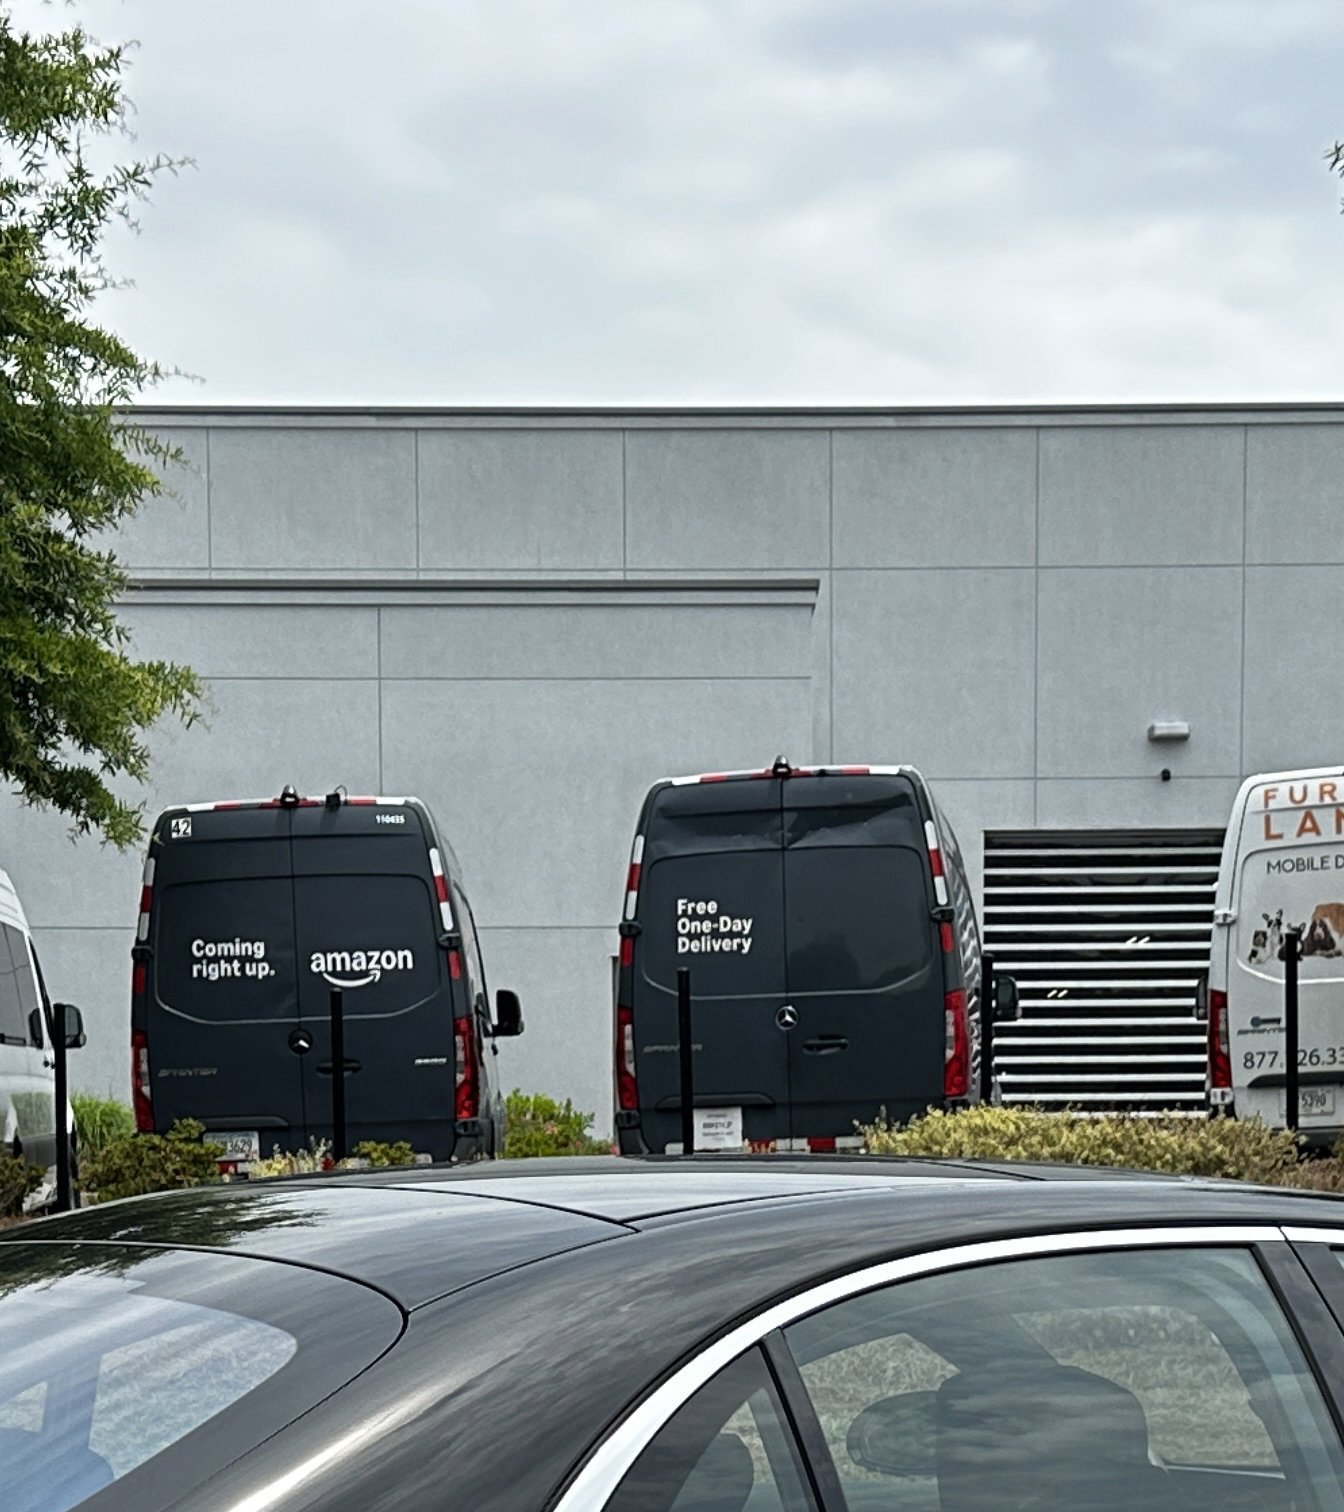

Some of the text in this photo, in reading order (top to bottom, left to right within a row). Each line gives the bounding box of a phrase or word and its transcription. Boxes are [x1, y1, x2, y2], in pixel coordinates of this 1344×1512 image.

[171, 818, 191, 837] 42
[1266, 854, 1331, 875] MOBILE
[677, 898, 718, 915] Free
[677, 915, 753, 935] One-Day
[192, 938, 265, 959] Coming
[677, 935, 752, 954] Delivery
[192, 958, 276, 981] right up.
[310, 949, 414, 973] amazon
